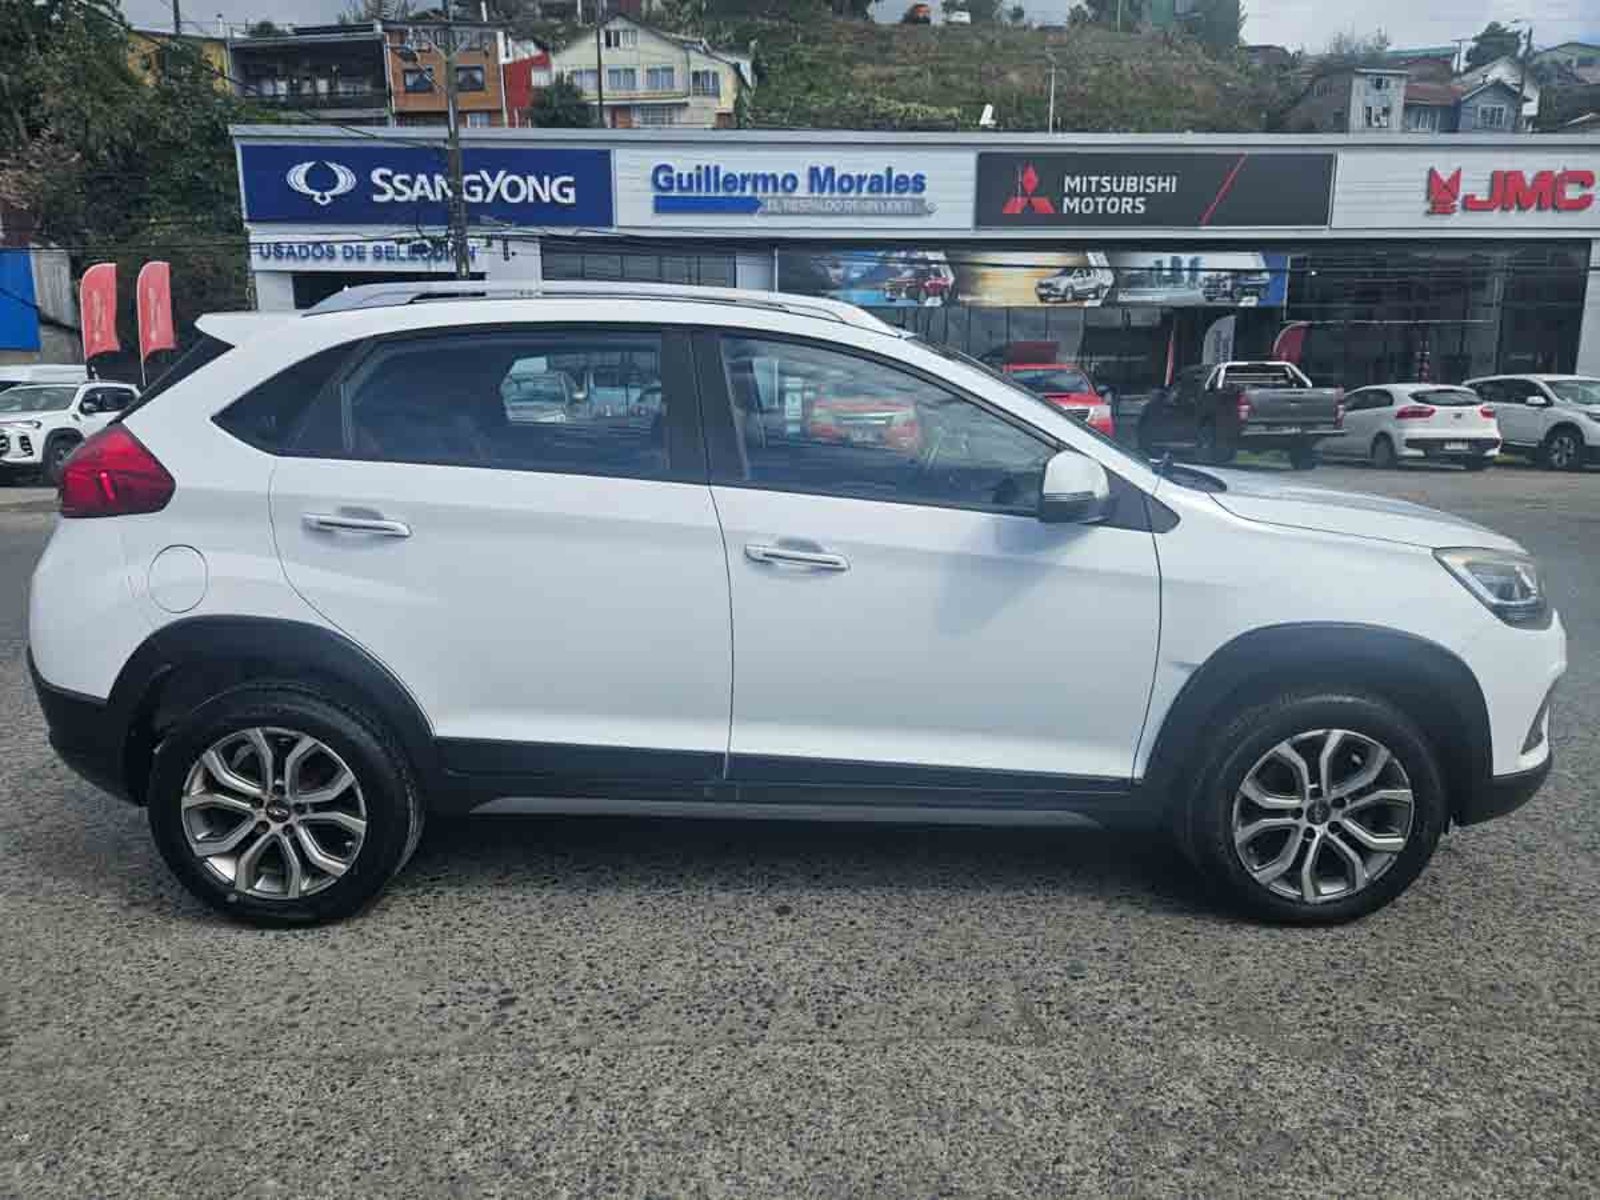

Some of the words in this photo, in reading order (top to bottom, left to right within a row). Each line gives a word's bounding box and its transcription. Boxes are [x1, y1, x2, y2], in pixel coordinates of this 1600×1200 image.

[652, 163, 798, 195] Guillermo
[808, 166, 928, 195] Morales
[1063, 175, 1178, 194] MITSUBISHI
[1462, 169, 1595, 211] JMC
[1062, 196, 1148, 214] MOTORS
[258, 243, 336, 262] USADOS
[343, 243, 369, 261] DE
